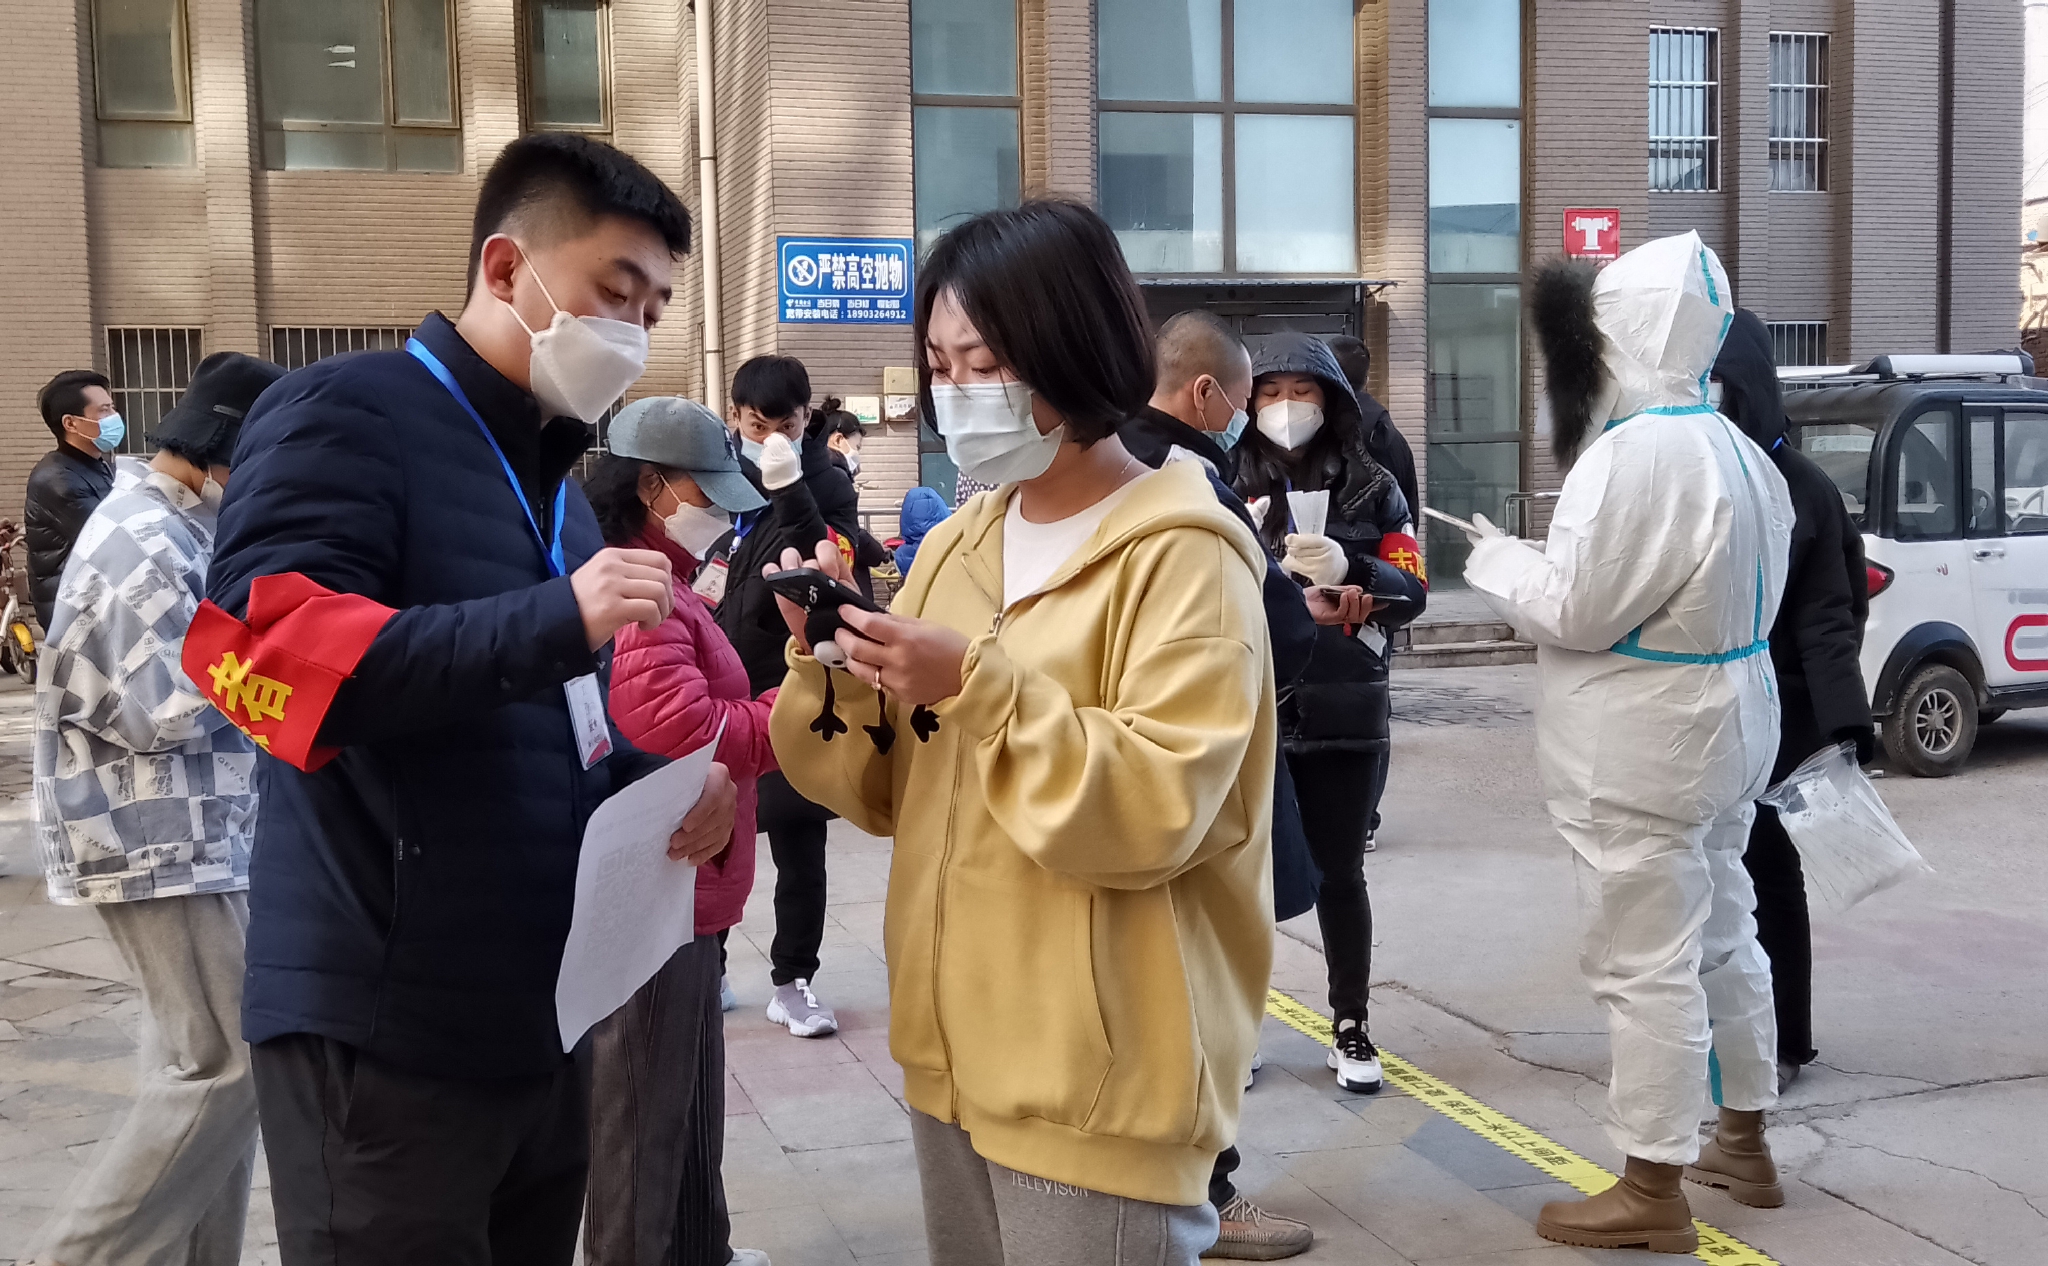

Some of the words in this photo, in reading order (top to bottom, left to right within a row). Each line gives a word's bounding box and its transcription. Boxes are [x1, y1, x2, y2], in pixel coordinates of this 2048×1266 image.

[817, 252, 903, 292] 严禁高空抛物
[206, 651, 294, 754] 者
[1440, 1100, 1574, 1166] 保持一米以上间距
